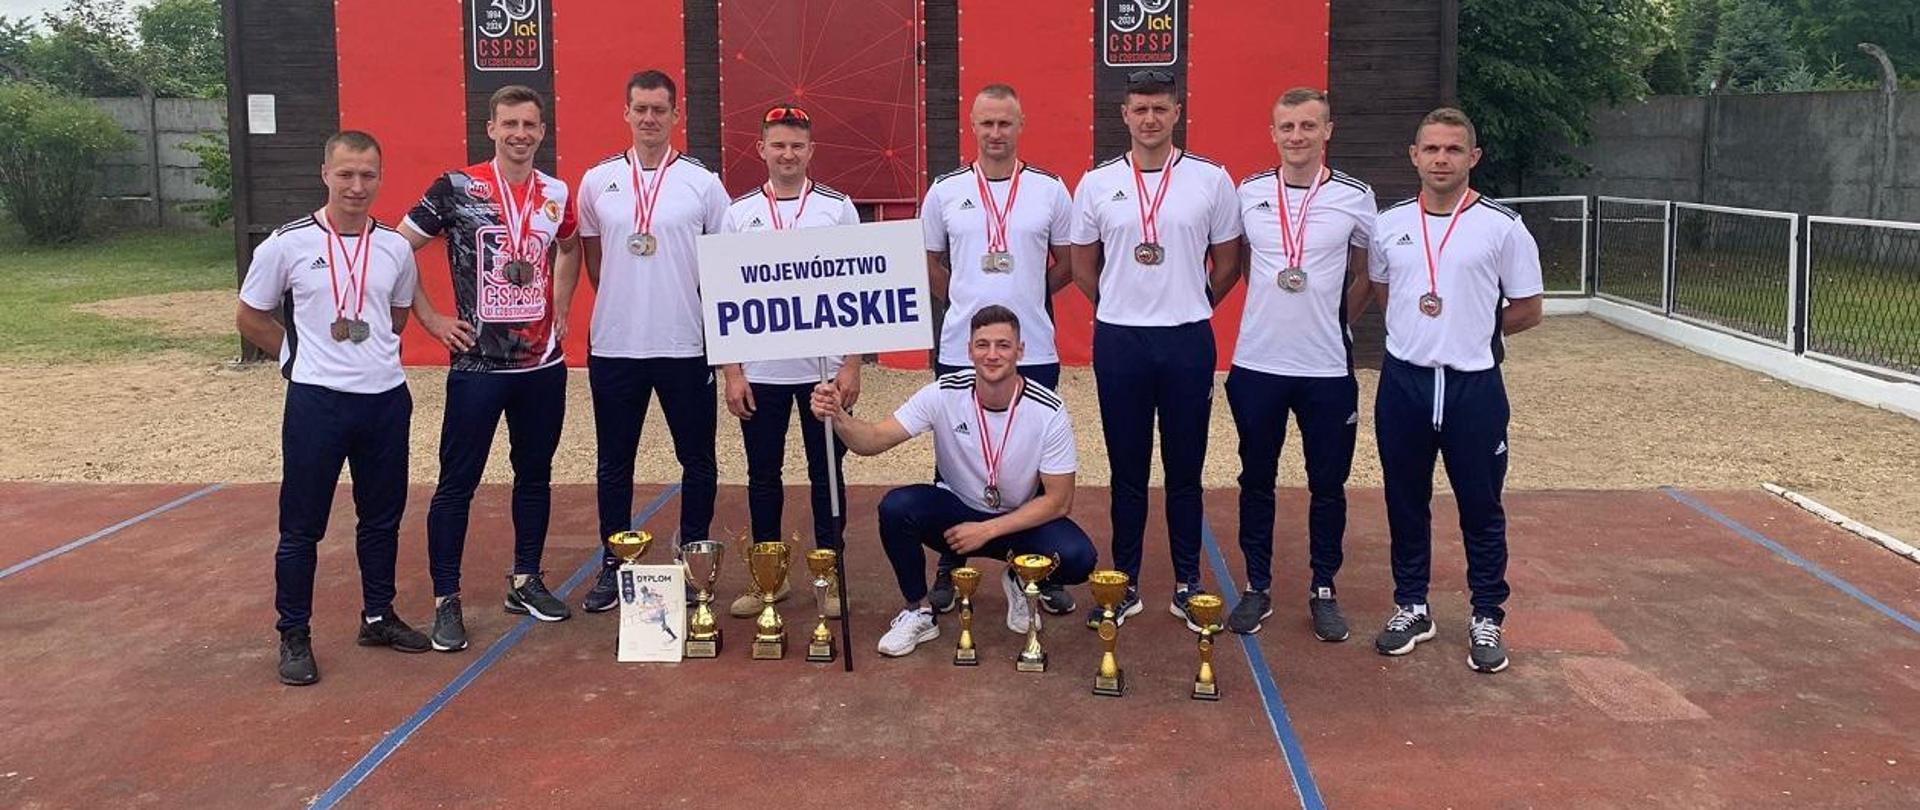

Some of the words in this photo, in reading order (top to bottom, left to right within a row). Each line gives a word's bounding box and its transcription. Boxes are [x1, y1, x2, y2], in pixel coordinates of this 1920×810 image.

[514, 21, 536, 36] lat
[1147, 14, 1172, 30] lat
[479, 39, 538, 57] CSPSP
[1110, 33, 1172, 52] CSPSP
[741, 255, 887, 284] WOJEWÓDZTWO
[485, 286, 541, 306] CSPSP
[717, 288, 919, 336] PODLASKIE
[636, 575, 672, 583] DYPLOM
